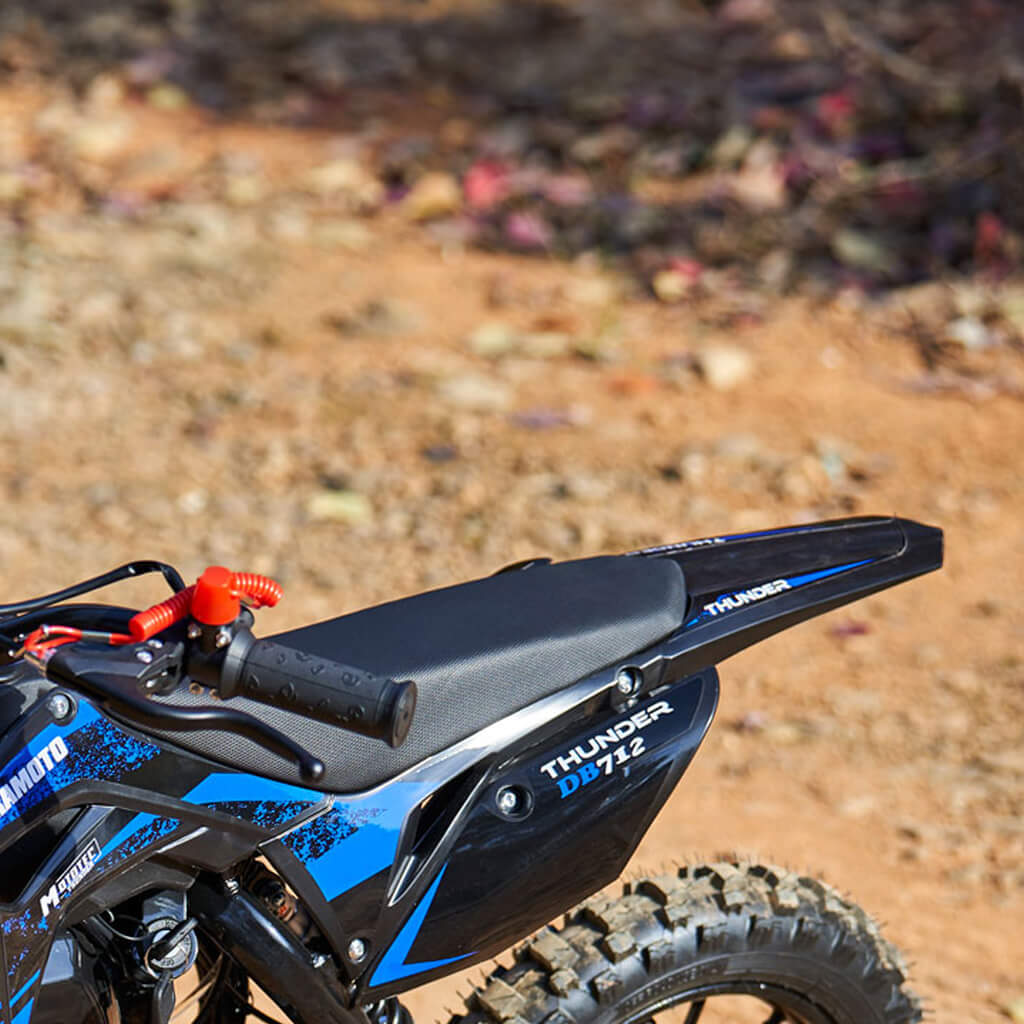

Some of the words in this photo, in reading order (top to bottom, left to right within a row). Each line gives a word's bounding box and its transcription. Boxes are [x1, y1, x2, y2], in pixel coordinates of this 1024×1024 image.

[704, 579, 791, 616] THUNDER
[540, 701, 674, 779] THUNDER
[556, 736, 646, 799] DB712
